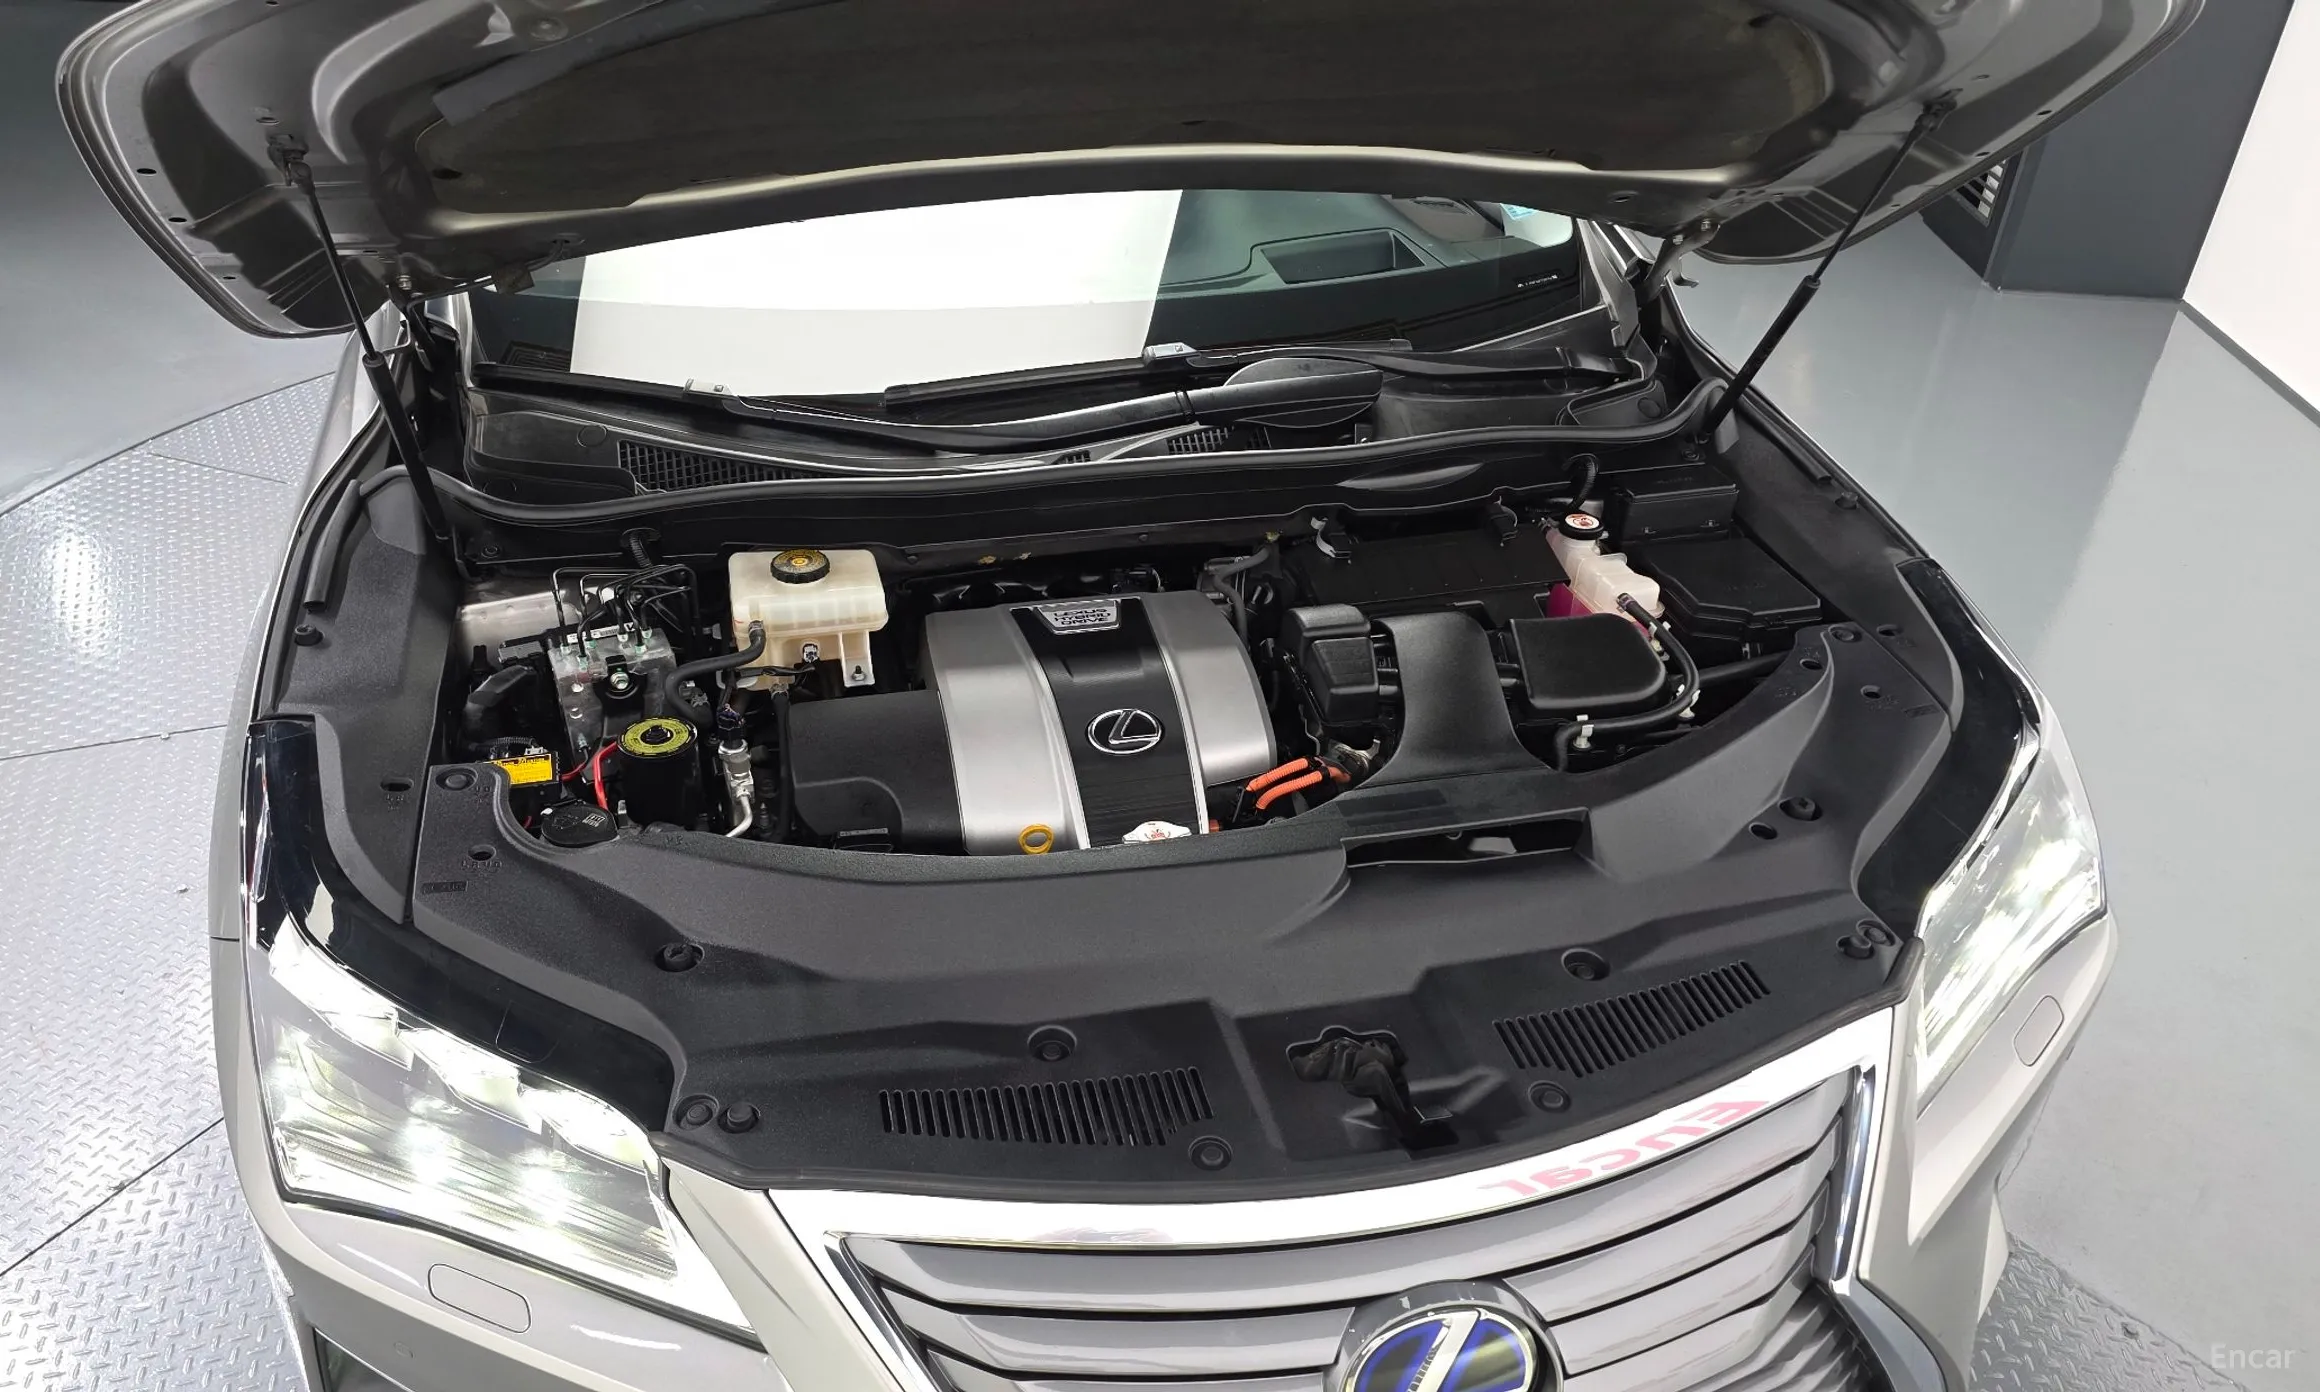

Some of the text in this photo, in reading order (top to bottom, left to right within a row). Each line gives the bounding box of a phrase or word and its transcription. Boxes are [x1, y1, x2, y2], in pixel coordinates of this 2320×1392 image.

[1054, 609, 1107, 617] LEXUS
[1054, 613, 1111, 621] HYBRID
[1061, 617, 1108, 625] DRIVE
